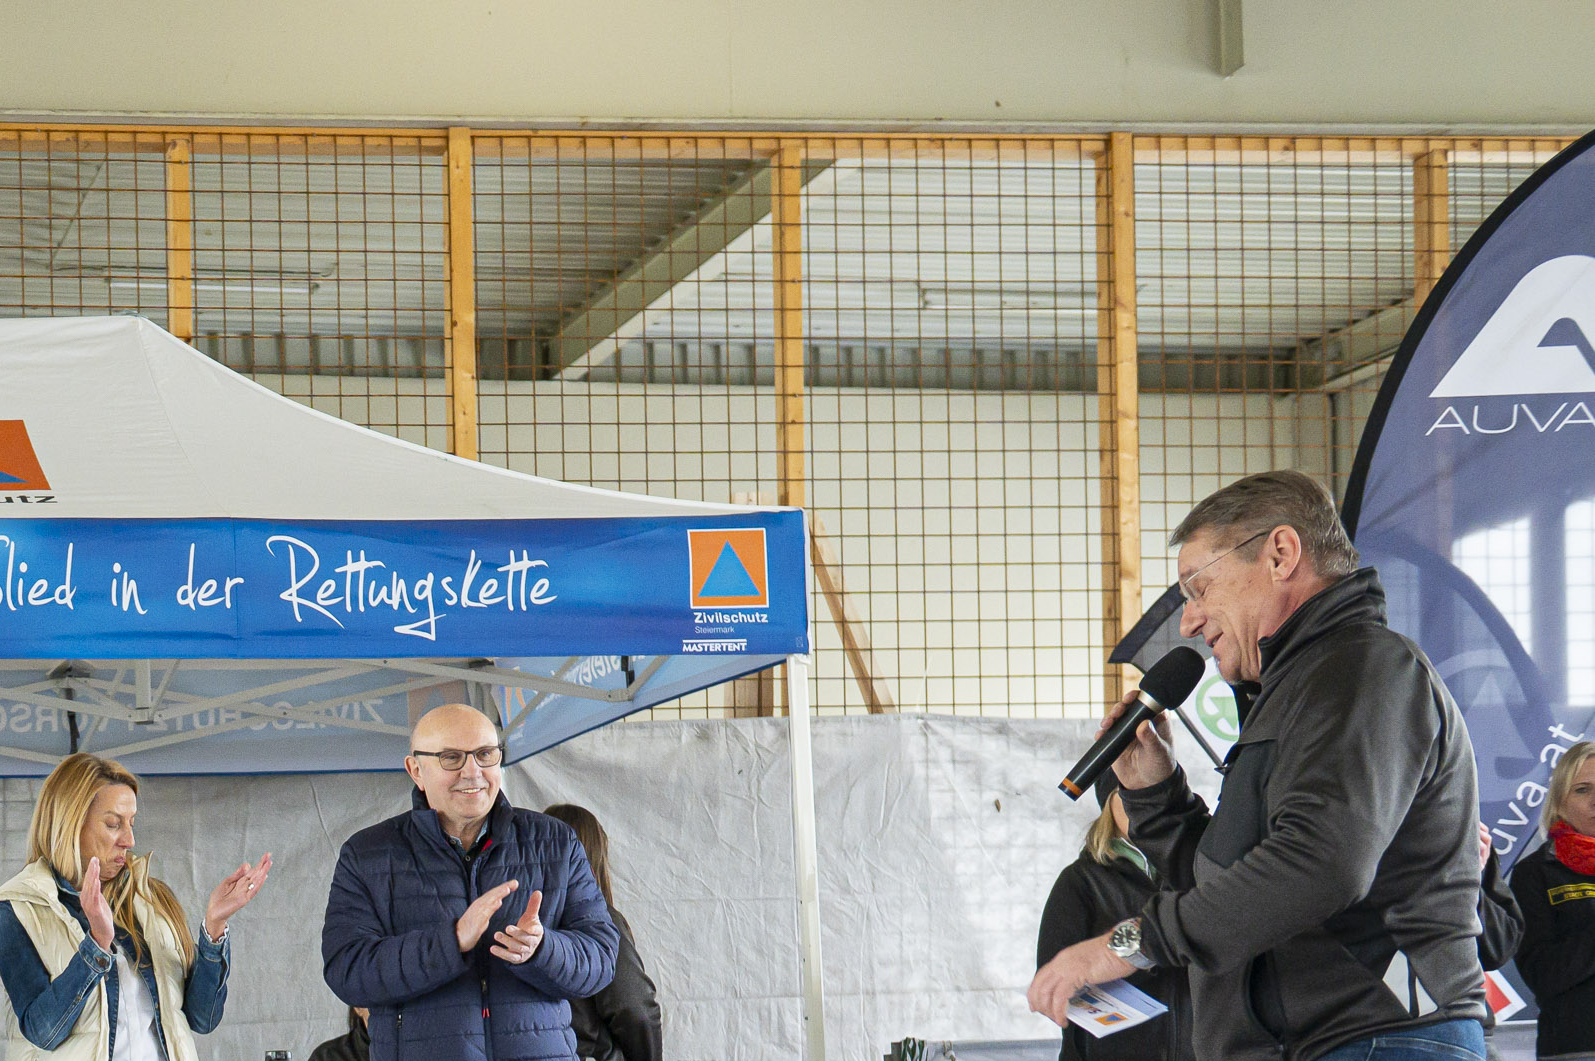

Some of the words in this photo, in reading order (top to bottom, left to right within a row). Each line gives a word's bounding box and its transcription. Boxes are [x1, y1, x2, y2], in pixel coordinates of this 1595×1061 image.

[1424, 401, 1595, 436] AUVA
[110, 563, 148, 615] in
[176, 542, 245, 611] der
[265, 535, 558, 641] Rettungskette
[693, 611, 769, 624] Zivilschutz
[694, 625, 736, 634] Steiermark
[682, 642, 748, 652] MASTERTENT
